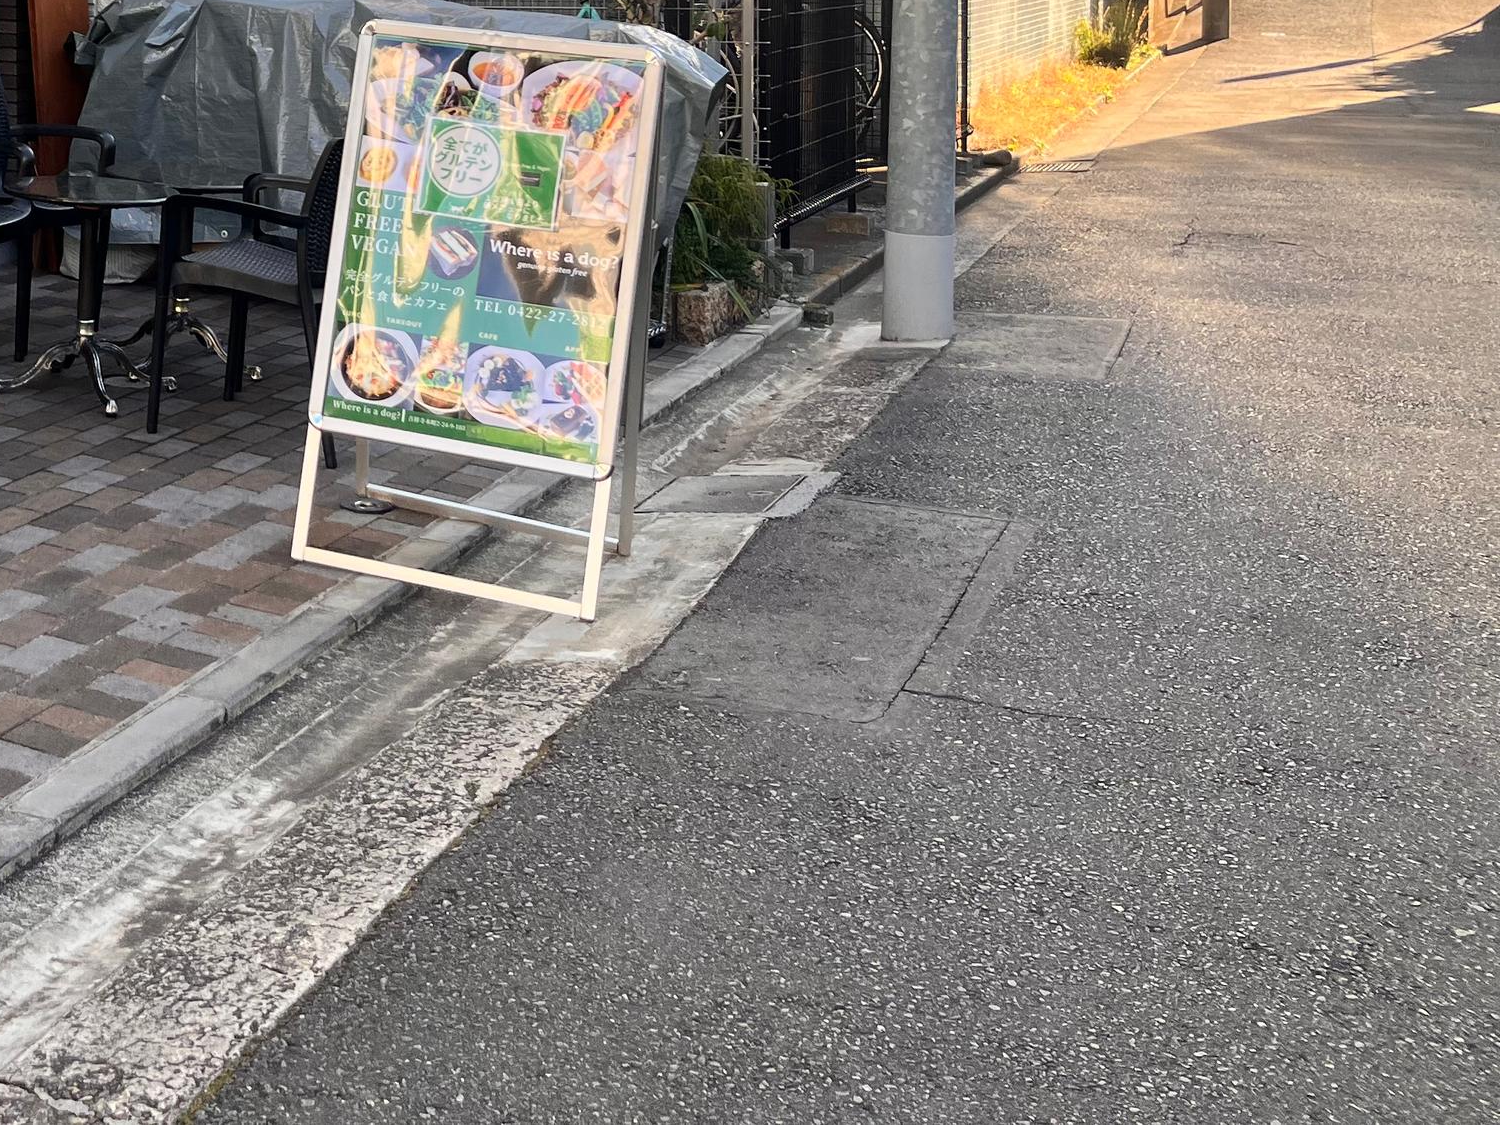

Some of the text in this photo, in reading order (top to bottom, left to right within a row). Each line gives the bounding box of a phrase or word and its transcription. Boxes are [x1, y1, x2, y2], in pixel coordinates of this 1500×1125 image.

[443, 136, 488, 155] 全てが
[435, 151, 492, 171] グルテン
[440, 167, 483, 184] フリー
[354, 212, 404, 234] FREE
[490, 238, 620, 272] Where is a dog?
[474, 299, 503, 315] TEL
[332, 399, 401, 422] Where is a dog?
